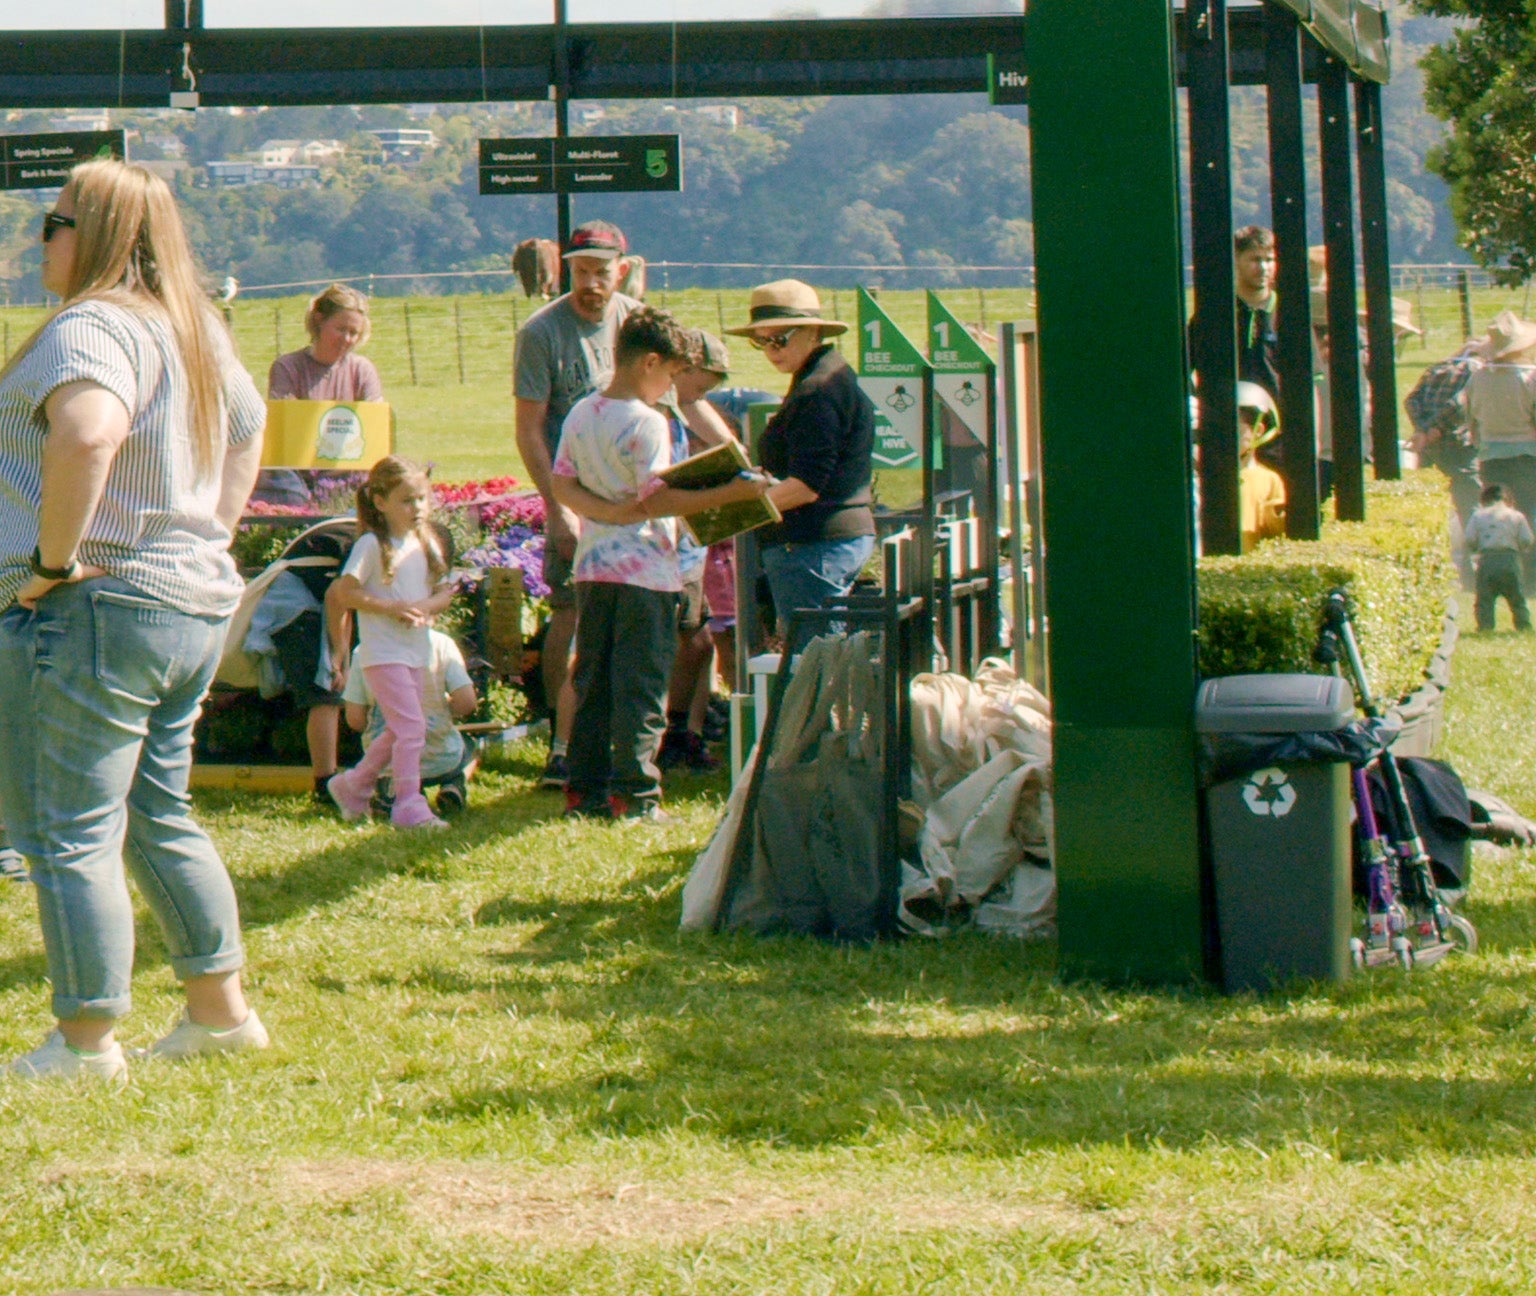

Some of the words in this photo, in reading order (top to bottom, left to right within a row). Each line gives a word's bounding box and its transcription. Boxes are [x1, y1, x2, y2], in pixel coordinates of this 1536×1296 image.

[999, 71, 1028, 87] Hiv
[14, 149, 40, 158] Spring
[42, 146, 74, 157] Specials
[645, 149, 668, 179] 5
[491, 175, 511, 185] High
[512, 175, 539, 183] nectar
[864, 320, 881, 349] 1
[934, 322, 950, 347] 1
[865, 352, 891, 363] BEE
[934, 351, 958, 361] BEE
[865, 364, 916, 372] CHECKOUT
[882, 438, 906, 449] HIVE
